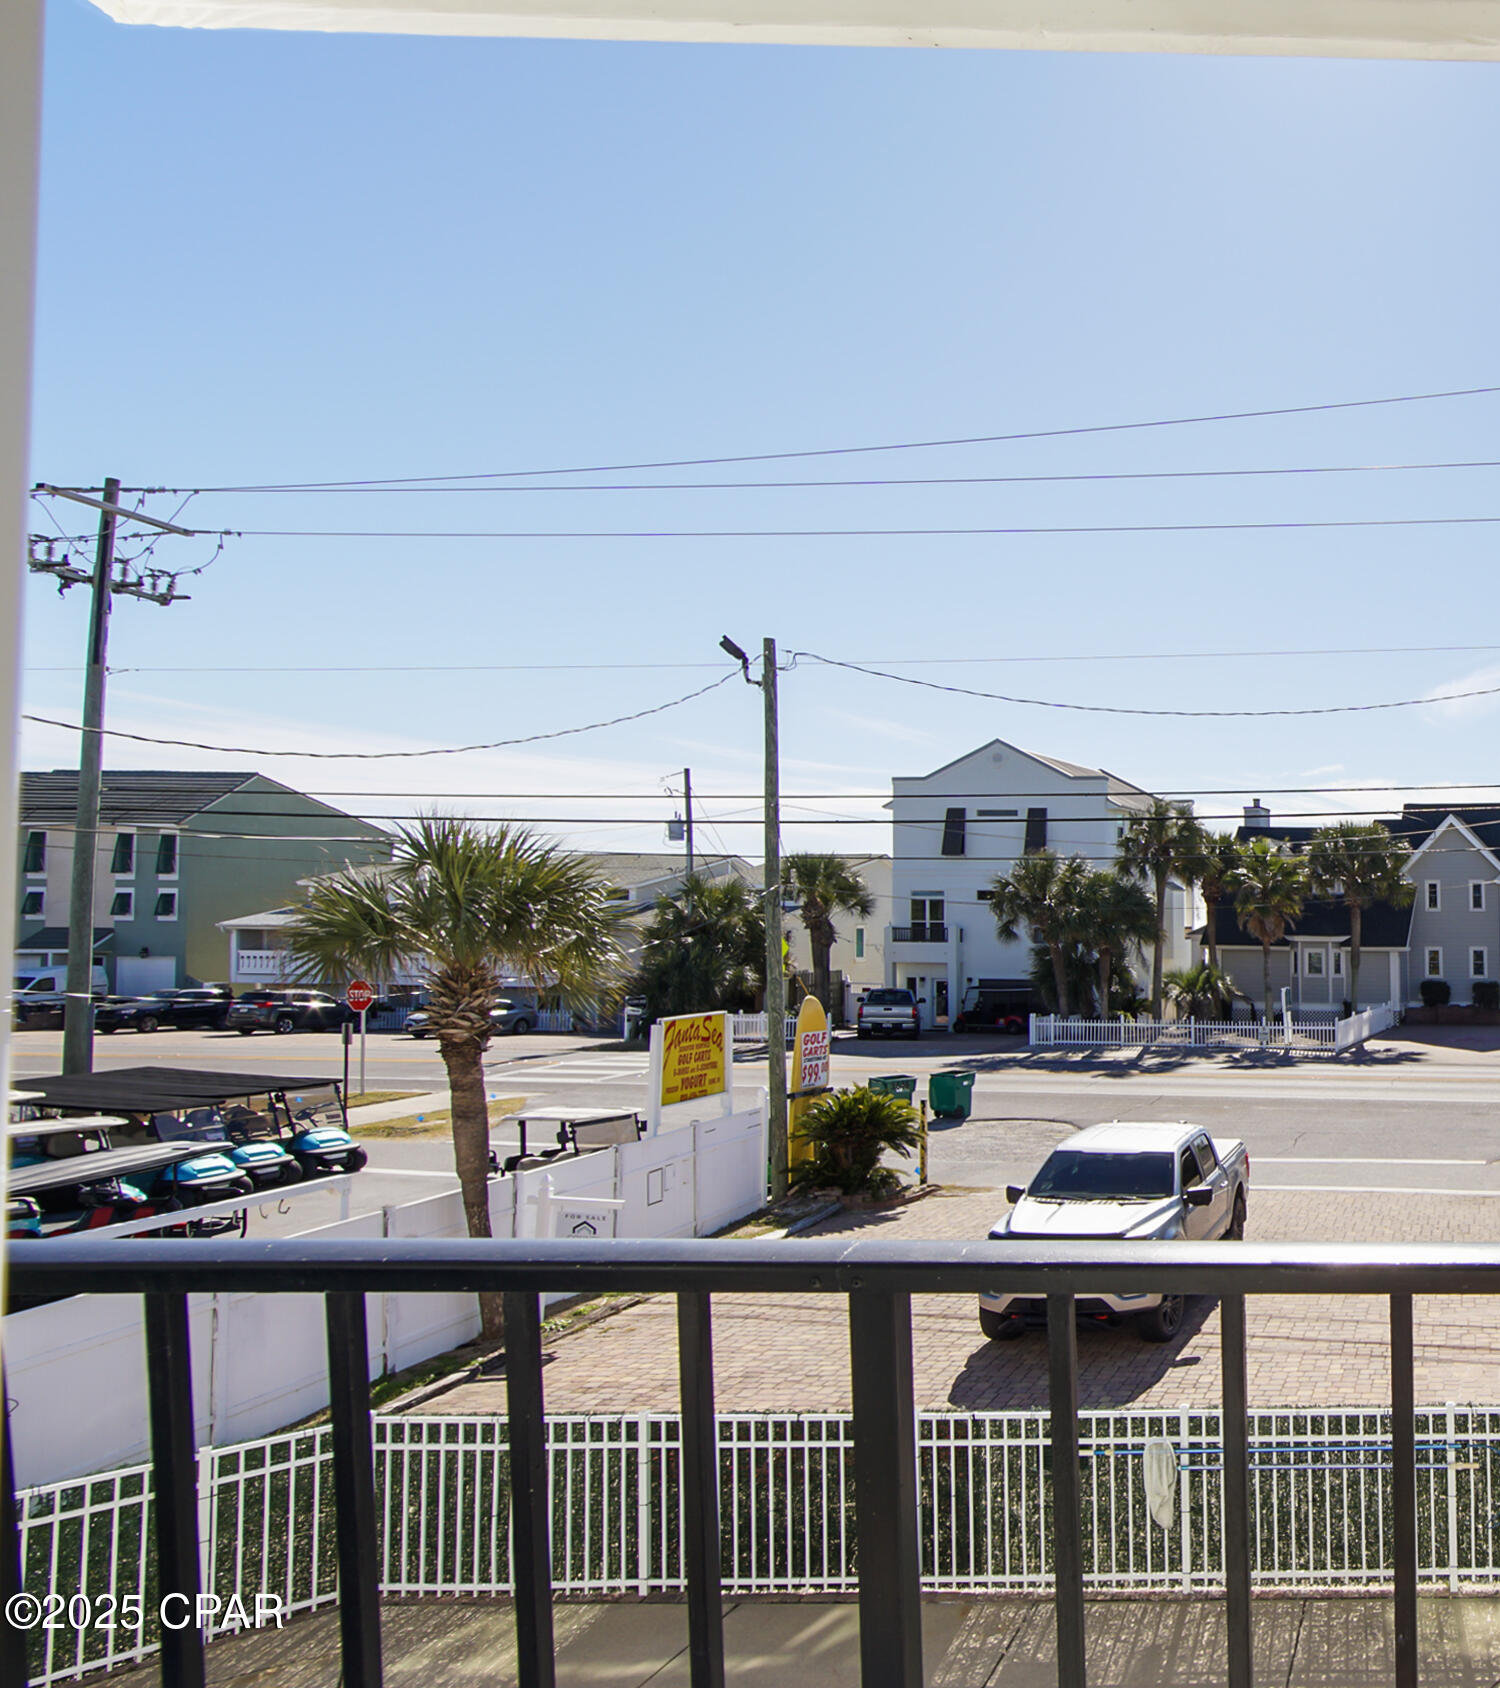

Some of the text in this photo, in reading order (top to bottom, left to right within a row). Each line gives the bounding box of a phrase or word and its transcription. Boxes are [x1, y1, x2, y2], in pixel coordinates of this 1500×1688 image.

[349, 990, 371, 1002] STOP
[803, 1031, 827, 1046] GOLF
[678, 1049, 712, 1066] GOLF CARTS
[803, 1045, 829, 1058] CARTS
[680, 1073, 707, 1091] YOGURT
